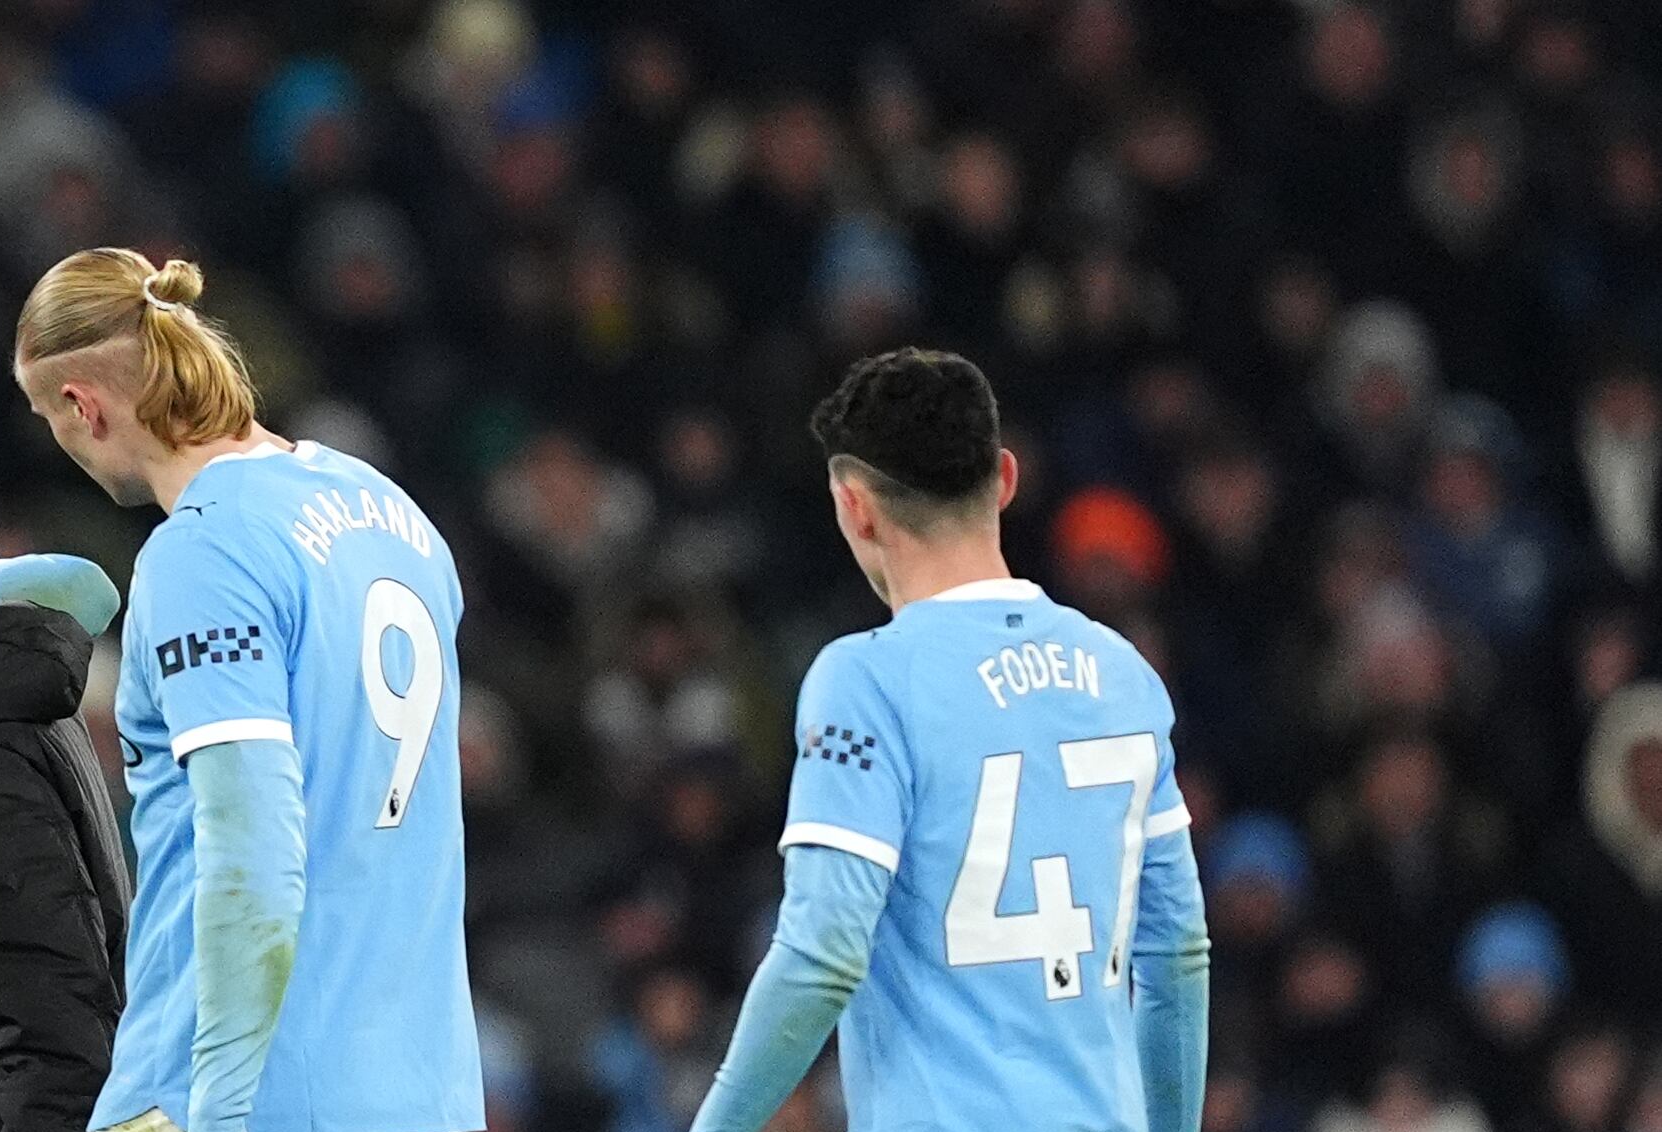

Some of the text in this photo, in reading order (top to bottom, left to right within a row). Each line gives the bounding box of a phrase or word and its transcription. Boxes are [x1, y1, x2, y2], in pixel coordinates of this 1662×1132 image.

[292, 488, 431, 567] HAALAND
[362, 577, 443, 828] 9
[977, 641, 1100, 709] FODEN
[944, 731, 1158, 1001] 47
